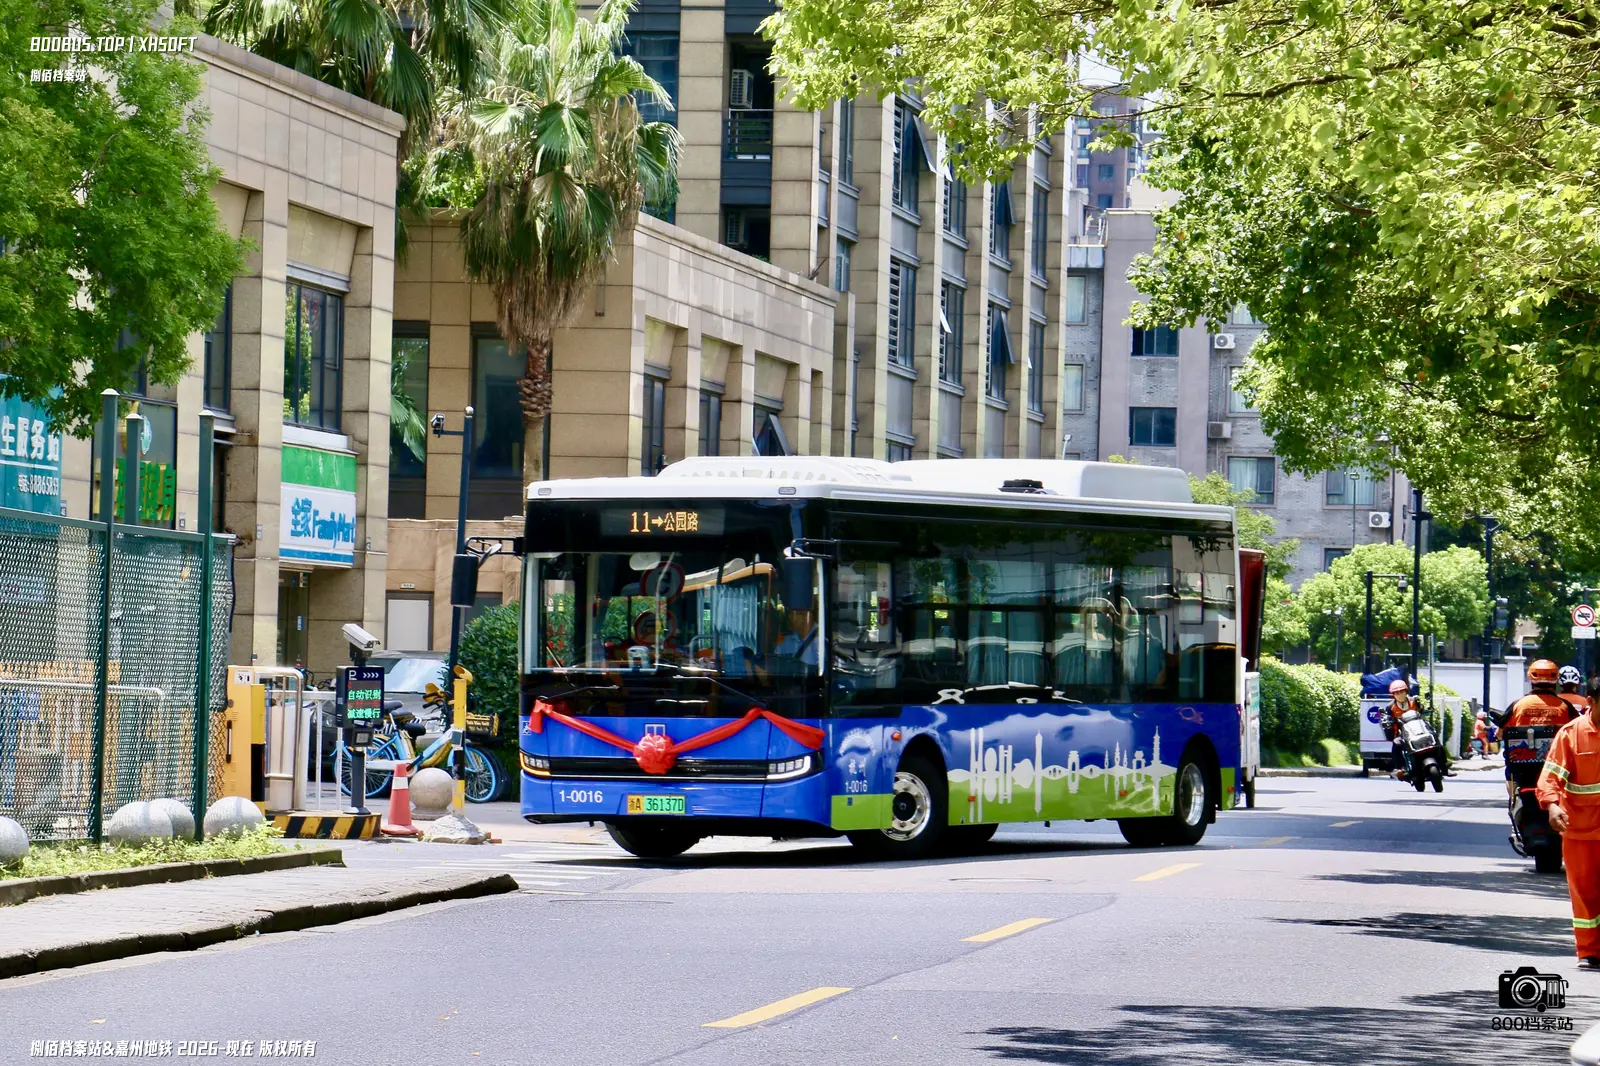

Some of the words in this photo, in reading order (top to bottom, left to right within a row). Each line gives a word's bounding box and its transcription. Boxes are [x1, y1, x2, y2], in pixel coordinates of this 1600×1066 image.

[630, 511, 651, 532] 11
[664, 511, 699, 532] 公园路
[348, 689, 381, 700] 自动识别
[347, 707, 380, 719] 减速慢行
[845, 780, 868, 793] 1-0016
[558, 789, 604, 803] 1-0016
[646, 797, 684, 812] 36137D
